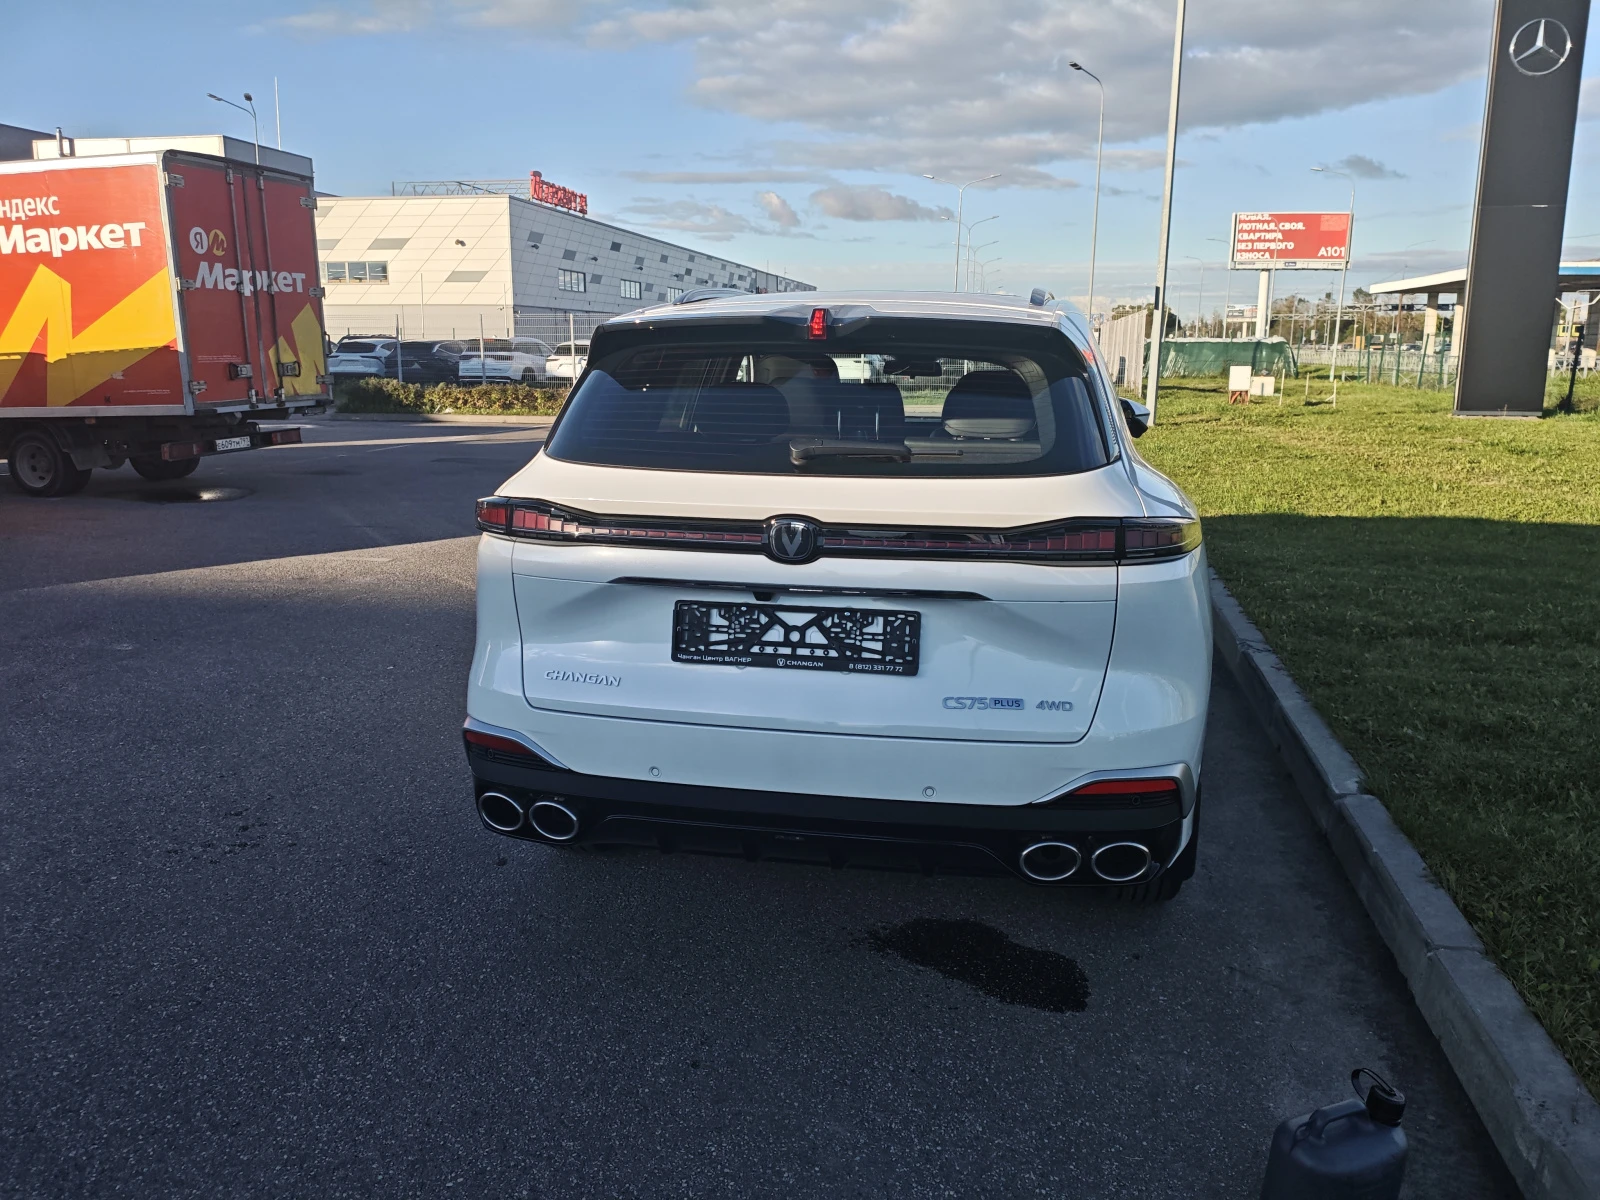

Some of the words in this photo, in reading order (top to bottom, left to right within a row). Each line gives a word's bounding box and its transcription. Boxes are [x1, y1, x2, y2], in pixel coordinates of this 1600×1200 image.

[0, 196, 60, 221] ндекс
[1279, 222, 1306, 231] СВОЯ.
[0, 221, 146, 258] Маркет
[1238, 232, 1283, 240] КВАРТИРА
[1253, 242, 1295, 250] ПЕРВОГО
[195, 261, 306, 297] Маркет
[702, 654, 724, 662] Центр
[855, 663, 872, 671] (812)
[543, 670, 622, 687] CHANGAN
[942, 696, 989, 711] CS75
[993, 700, 1021, 708] PLUS
[1035, 700, 1074, 711] 4WD
